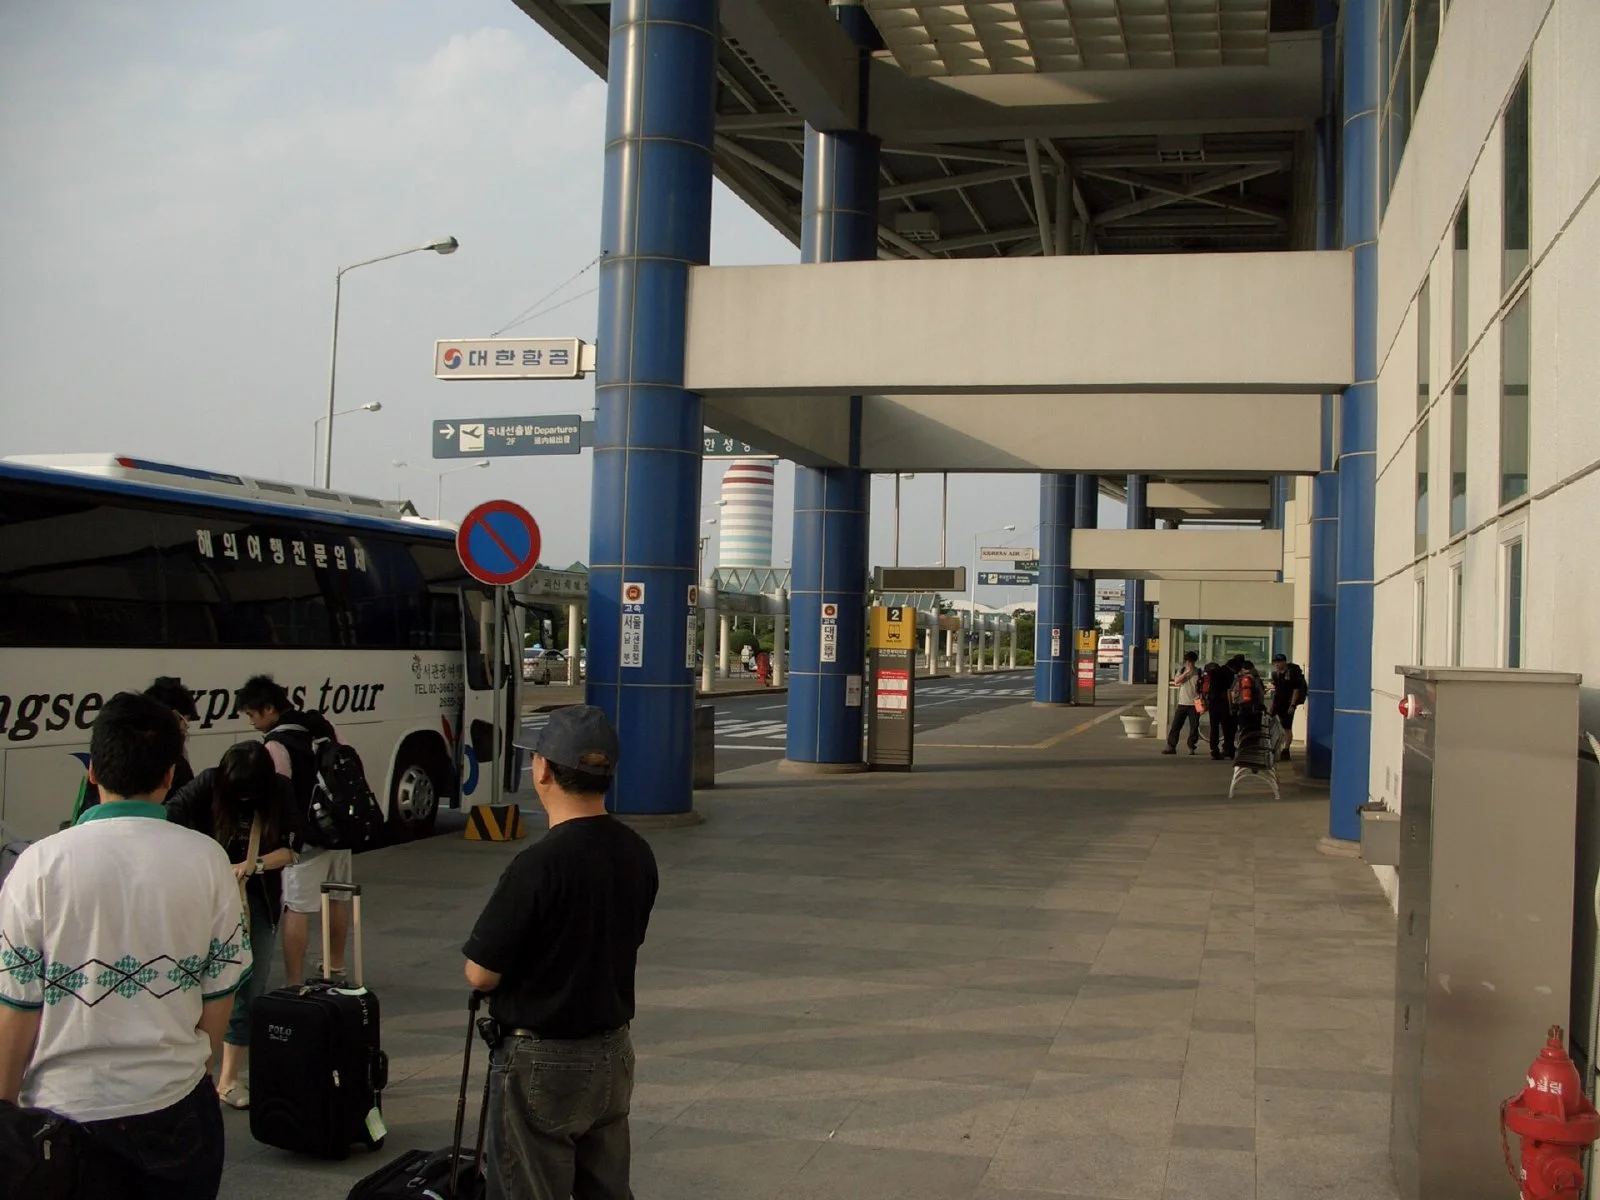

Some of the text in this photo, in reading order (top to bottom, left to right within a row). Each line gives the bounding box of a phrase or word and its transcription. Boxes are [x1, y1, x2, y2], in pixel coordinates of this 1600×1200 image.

[469, 349, 569, 366] 대한항공
[534, 425, 578, 435] Departures
[891, 609, 900, 620] 2
[414, 683, 427, 694] TEL
[318, 678, 384, 715] tour
[268, 1024, 292, 1036] POLO
